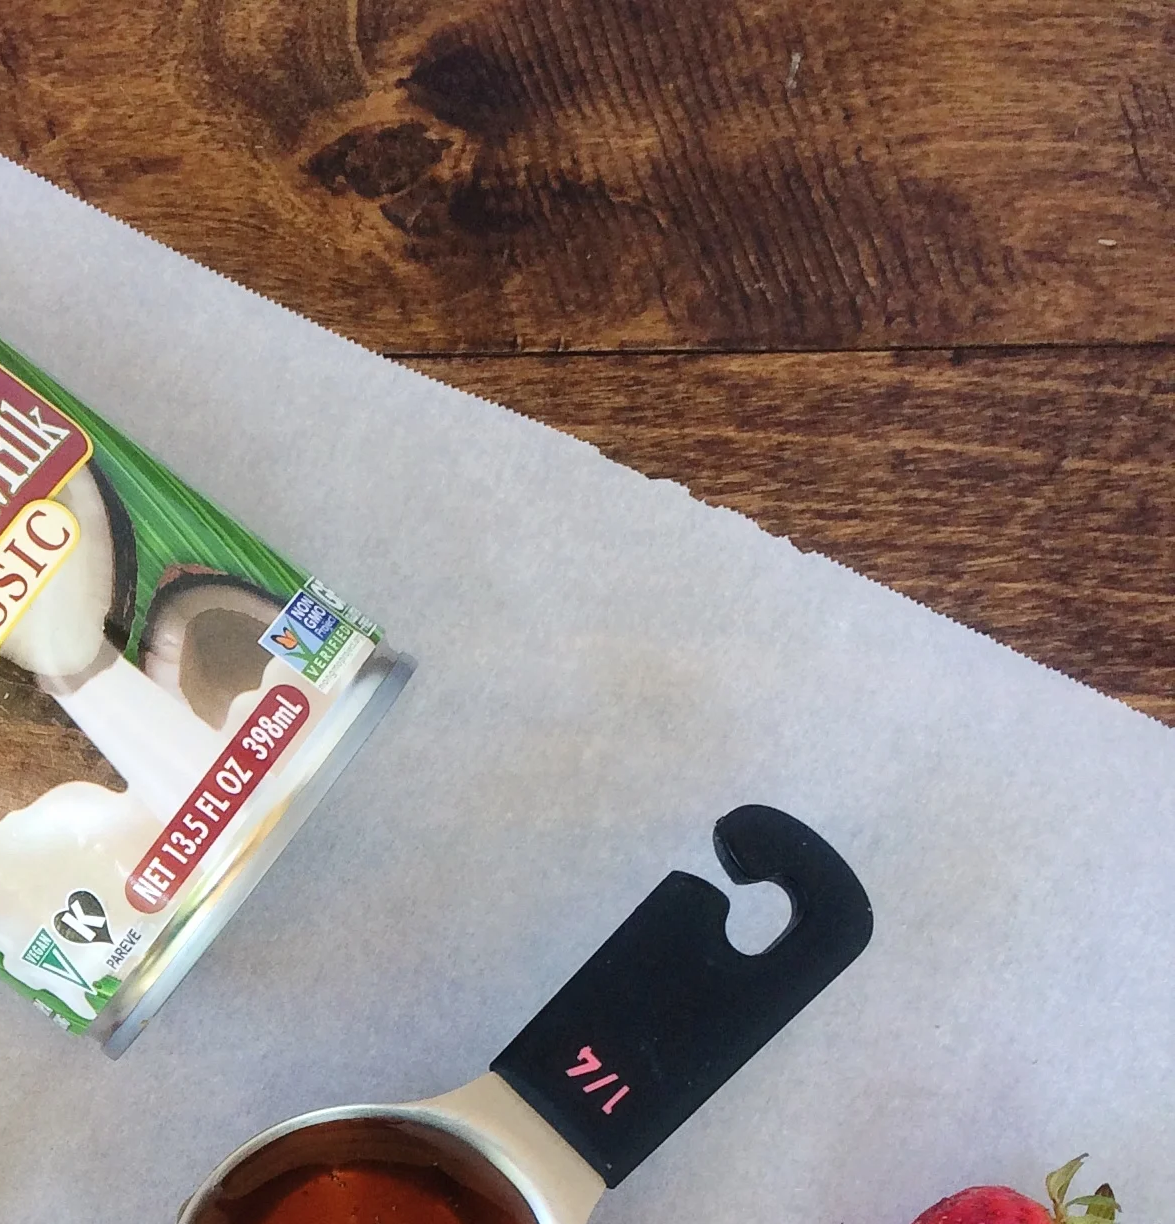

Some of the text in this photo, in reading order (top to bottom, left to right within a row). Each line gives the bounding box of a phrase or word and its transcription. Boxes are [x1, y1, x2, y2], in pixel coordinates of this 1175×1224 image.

[290, 595, 315, 621] NON
[303, 604, 327, 630] GMO
[315, 614, 338, 639] Project
[306, 623, 352, 677] VERIFIED
[131, 693, 305, 906] NET 13.5 FL OZ 398mL
[61, 900, 106, 942] K
[25, 933, 53, 965] VEGAN
[106, 928, 143, 970] PAREVE
